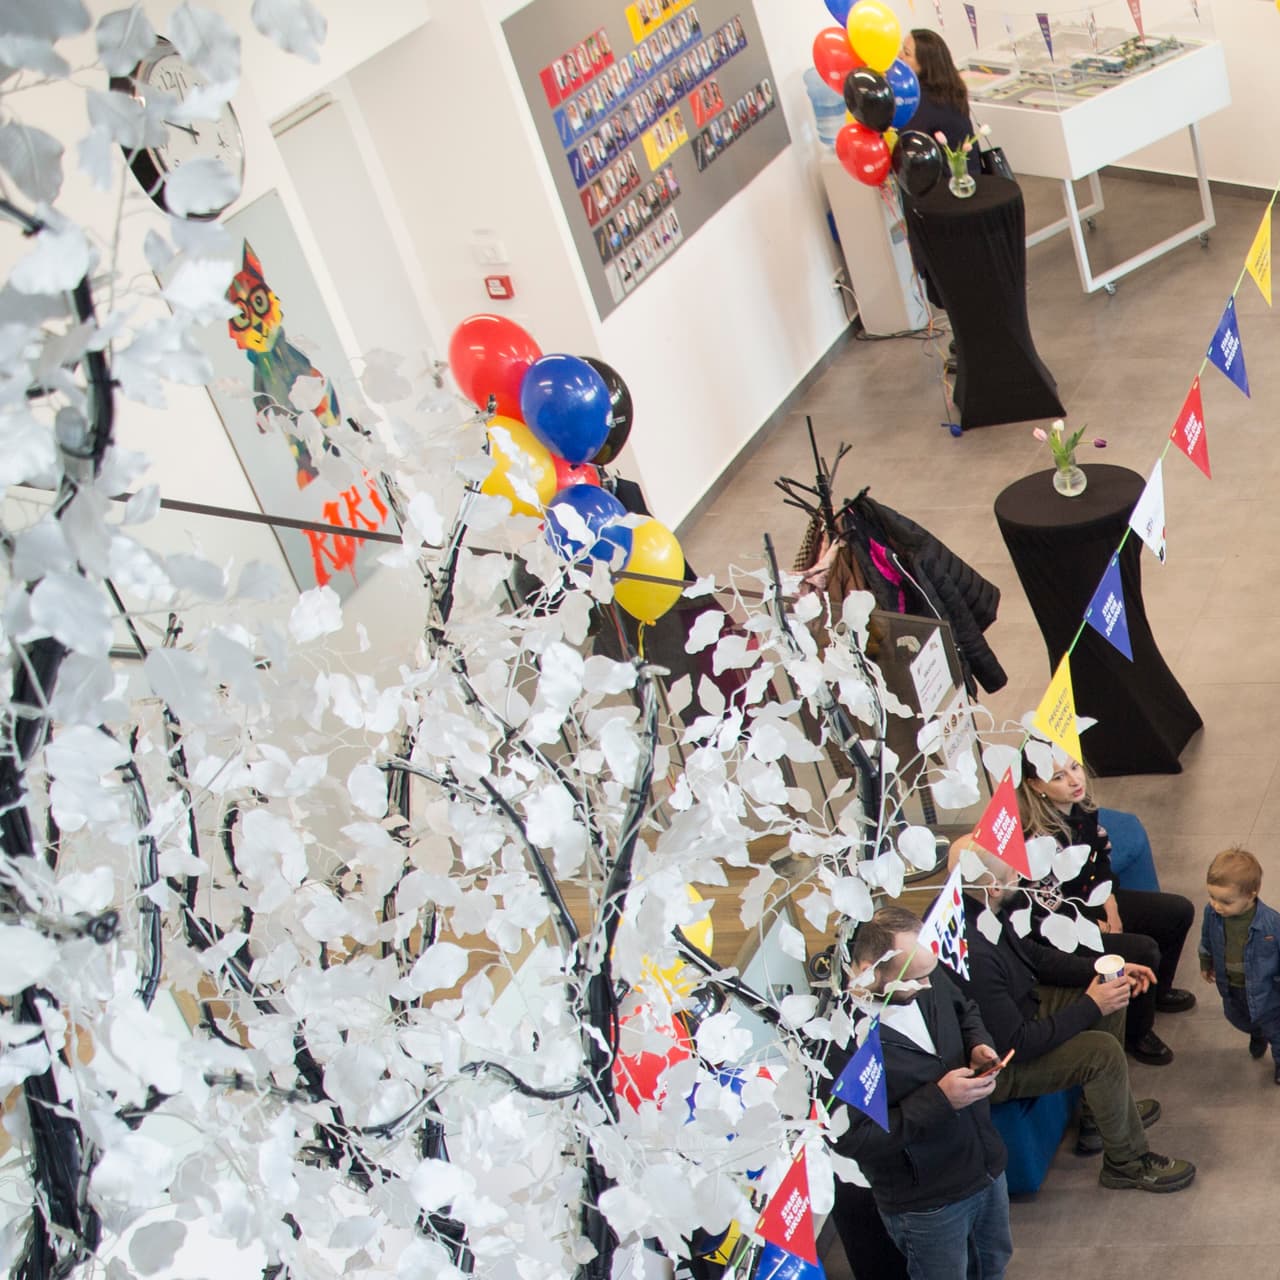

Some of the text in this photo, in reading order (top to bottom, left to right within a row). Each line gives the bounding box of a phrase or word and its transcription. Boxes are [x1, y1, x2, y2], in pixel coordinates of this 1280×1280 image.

[1101, 591, 1115, 617] STARK
[1106, 601, 1124, 637] ZUKUNFT
[992, 806, 1008, 835] STARK
[997, 815, 1018, 856] ZUKUNFT
[859, 1054, 876, 1083] STARK
[863, 1063, 882, 1106] ZUKUNFT
[781, 1187, 799, 1218] STARK
[784, 1195, 810, 1242] ZUKUNFT
